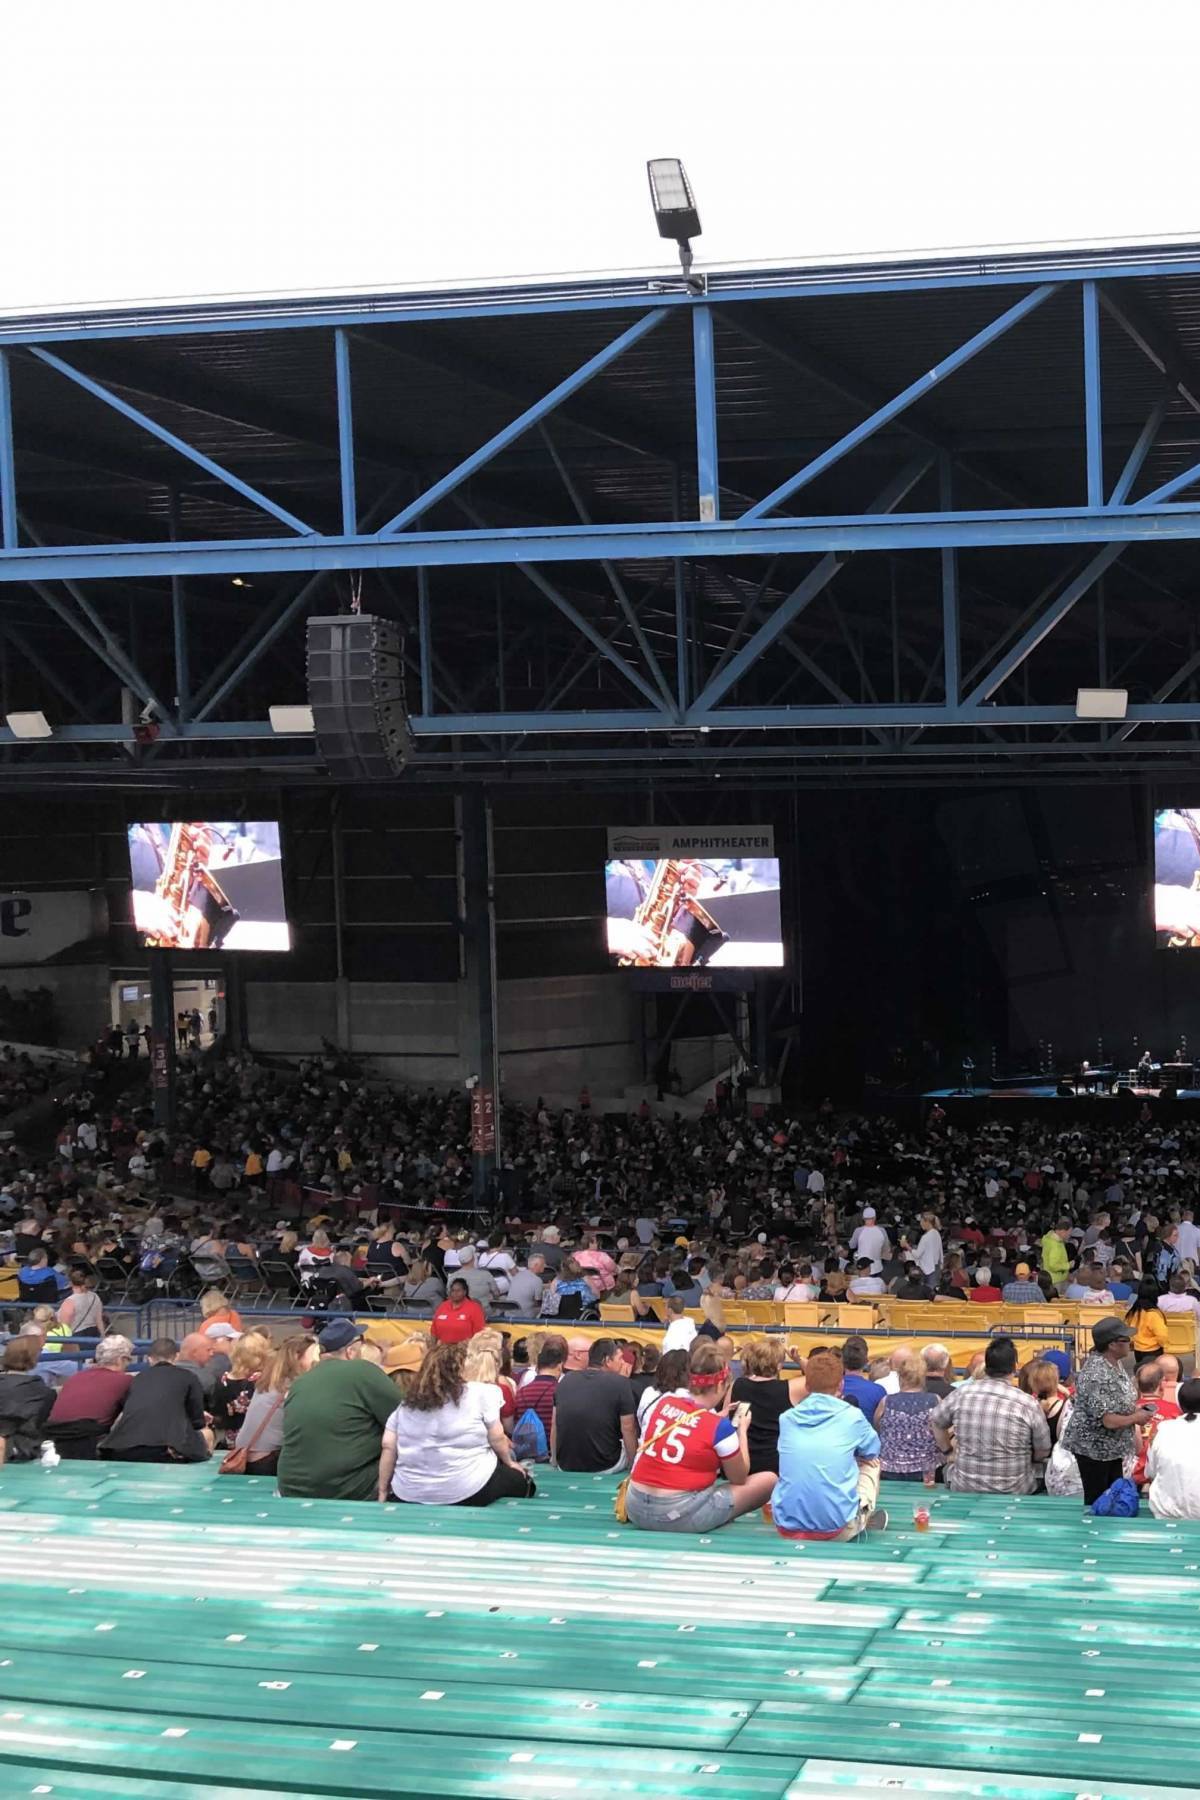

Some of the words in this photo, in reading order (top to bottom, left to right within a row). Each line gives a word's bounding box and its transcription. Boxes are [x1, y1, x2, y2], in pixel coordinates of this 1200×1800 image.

[672, 837, 769, 849] AMPHITHEATER
[474, 1103, 480, 1114] 2
[485, 1102, 492, 1113] 2
[645, 1418, 691, 1464] 15
